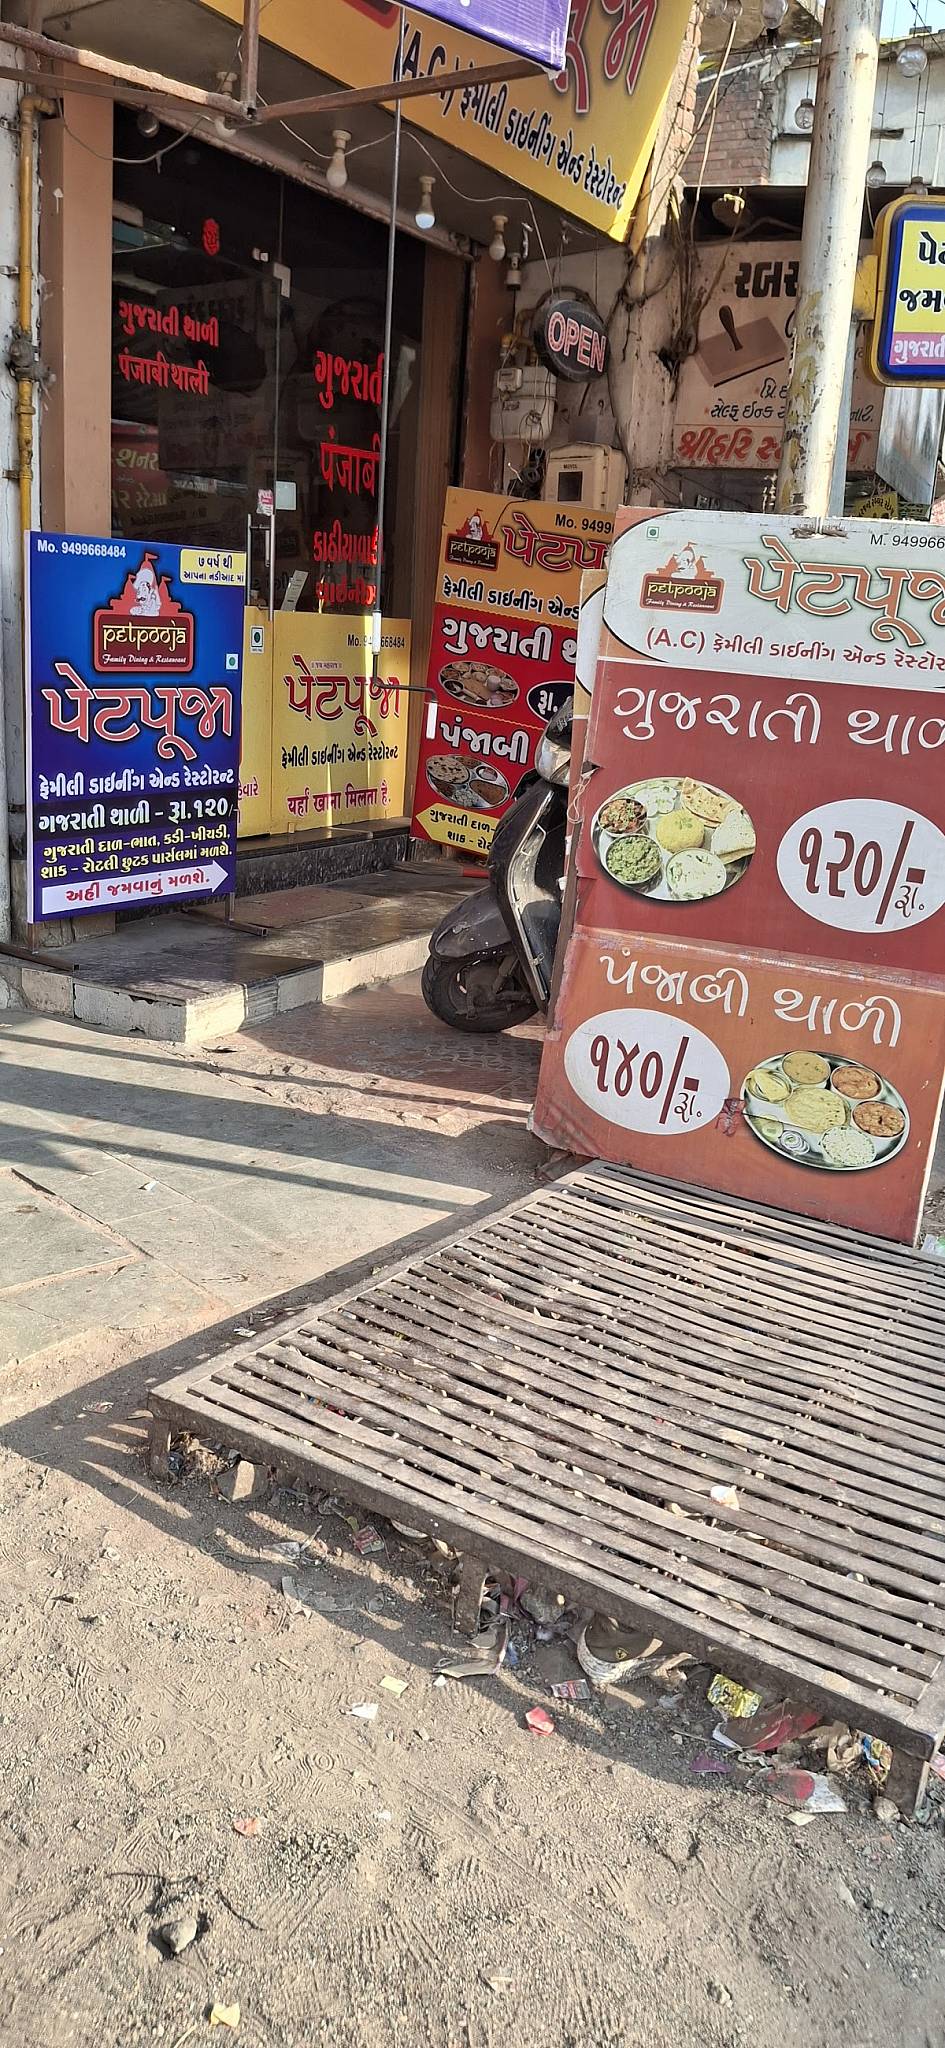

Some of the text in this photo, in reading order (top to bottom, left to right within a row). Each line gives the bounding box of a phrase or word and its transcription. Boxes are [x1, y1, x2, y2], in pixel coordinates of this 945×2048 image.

[557, 128, 585, 185] એન્ડ
[899, 289, 945, 313] જમ
[119, 300, 179, 336] ગુજરાતી
[547, 311, 607, 372] OPEN
[118, 346, 211, 395] पंजाबी थाली
[555, 513, 614, 534] Mo. 9499
[37, 539, 126, 558] Mo. 9499668484
[450, 540, 497, 561] petpooja
[870, 533, 886, 546] M.
[223, 554, 233, 569] થી
[442, 575, 483, 602] ફેમીલી
[648, 581, 718, 601] petpooja
[102, 619, 187, 652] petpooja
[347, 634, 405, 648] Mo. 94668484
[442, 617, 552, 663] ગુજરાતી
[646, 627, 706, 655] (A.C)
[713, 632, 764, 656] ફેમીલી
[843, 645, 886, 667] એન્ડ
[102, 653, 127, 665] Family
[128, 654, 148, 666] Dining
[41, 662, 233, 762] પેટપૂજા
[612, 686, 822, 743] ગુજરાતી
[281, 745, 309, 769] ફેમીલી
[348, 741, 366, 762] એન્ડ
[440, 716, 529, 765] પંજાબી
[38, 770, 84, 800] ફેમીલી
[150, 766, 179, 789] એન્ડ
[183, 763, 234, 788] રેસ્ટોરન્ટ
[313, 790, 342, 812] खाना
[346, 783, 377, 807] मिलता
[110, 800, 150, 826] થાળી
[430, 809, 468, 827] ગુજરાતી
[40, 865, 67, 879] શાક
[83, 854, 118, 874] રોટલી
[200, 841, 232, 859] મળશે.
[43, 838, 95, 864] ગુજરાતી
[168, 868, 210, 887] મળશે.
[799, 820, 926, 925] ૧૨૦/-
[599, 948, 902, 1048] પંજાબી થાળી
[590, 1035, 700, 1125] ૧૪૦/-
